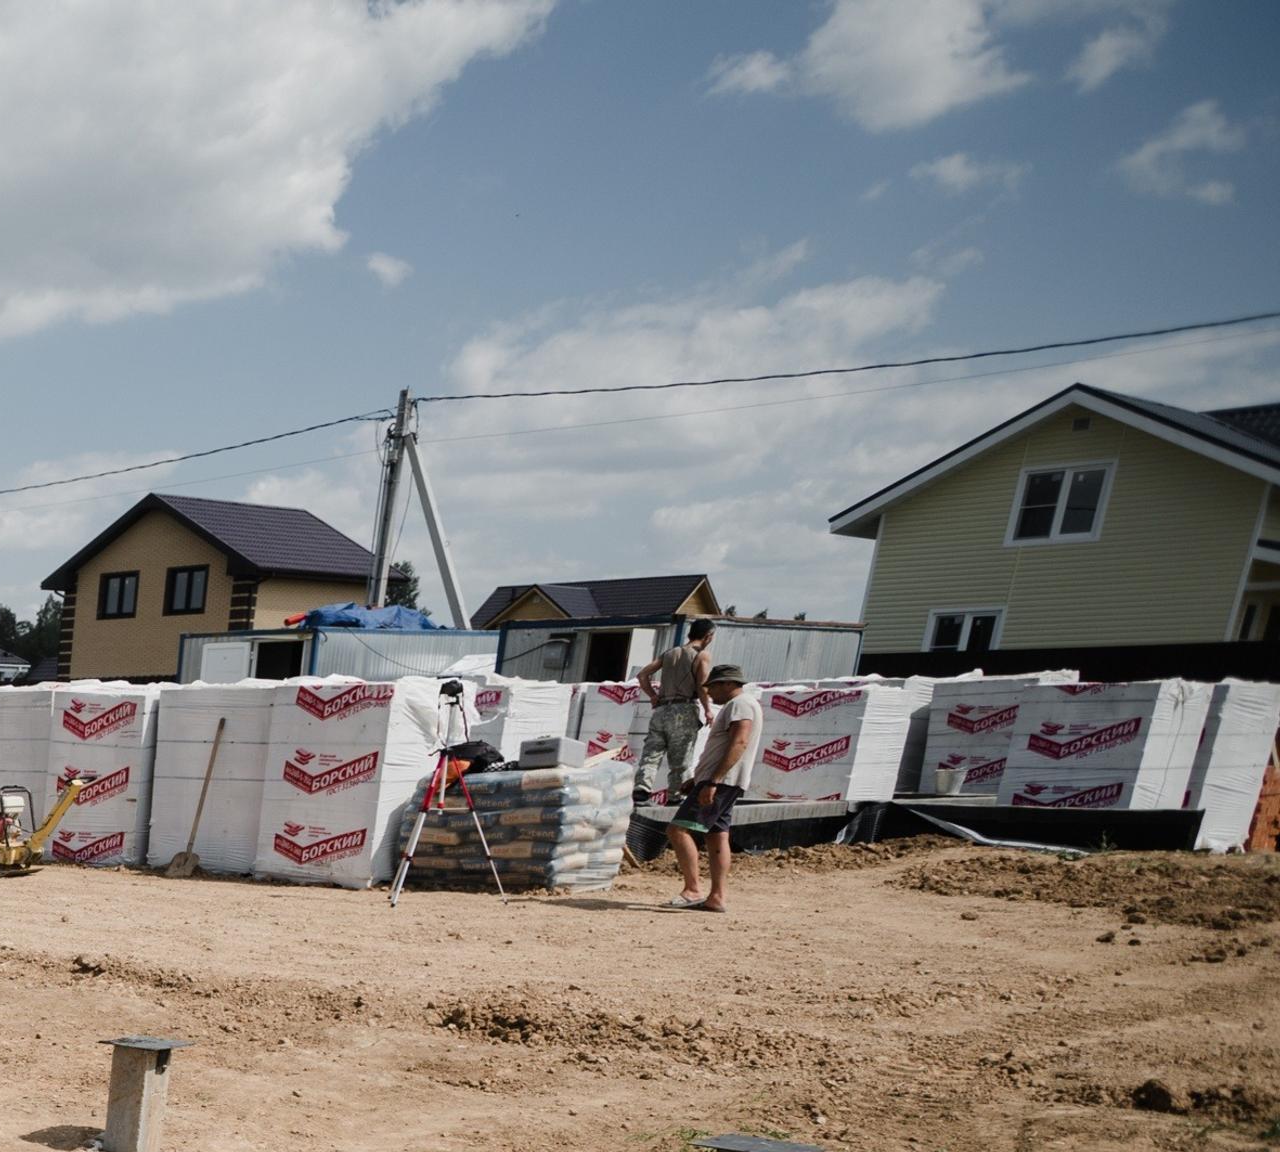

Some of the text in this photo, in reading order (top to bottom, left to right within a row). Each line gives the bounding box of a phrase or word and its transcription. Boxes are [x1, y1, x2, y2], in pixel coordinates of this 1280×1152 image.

[84, 702, 131, 737] БОРСКИЙ
[1060, 719, 1136, 755] БОРСКИЙ
[789, 739, 847, 770] БОРСКИЙ
[79, 770, 127, 803] БОРСКИЙ
[312, 754, 374, 790] БОРСКИЙ
[75, 834, 122, 863] БОРСКИЙ
[302, 832, 361, 861] БОРСКИЙ
